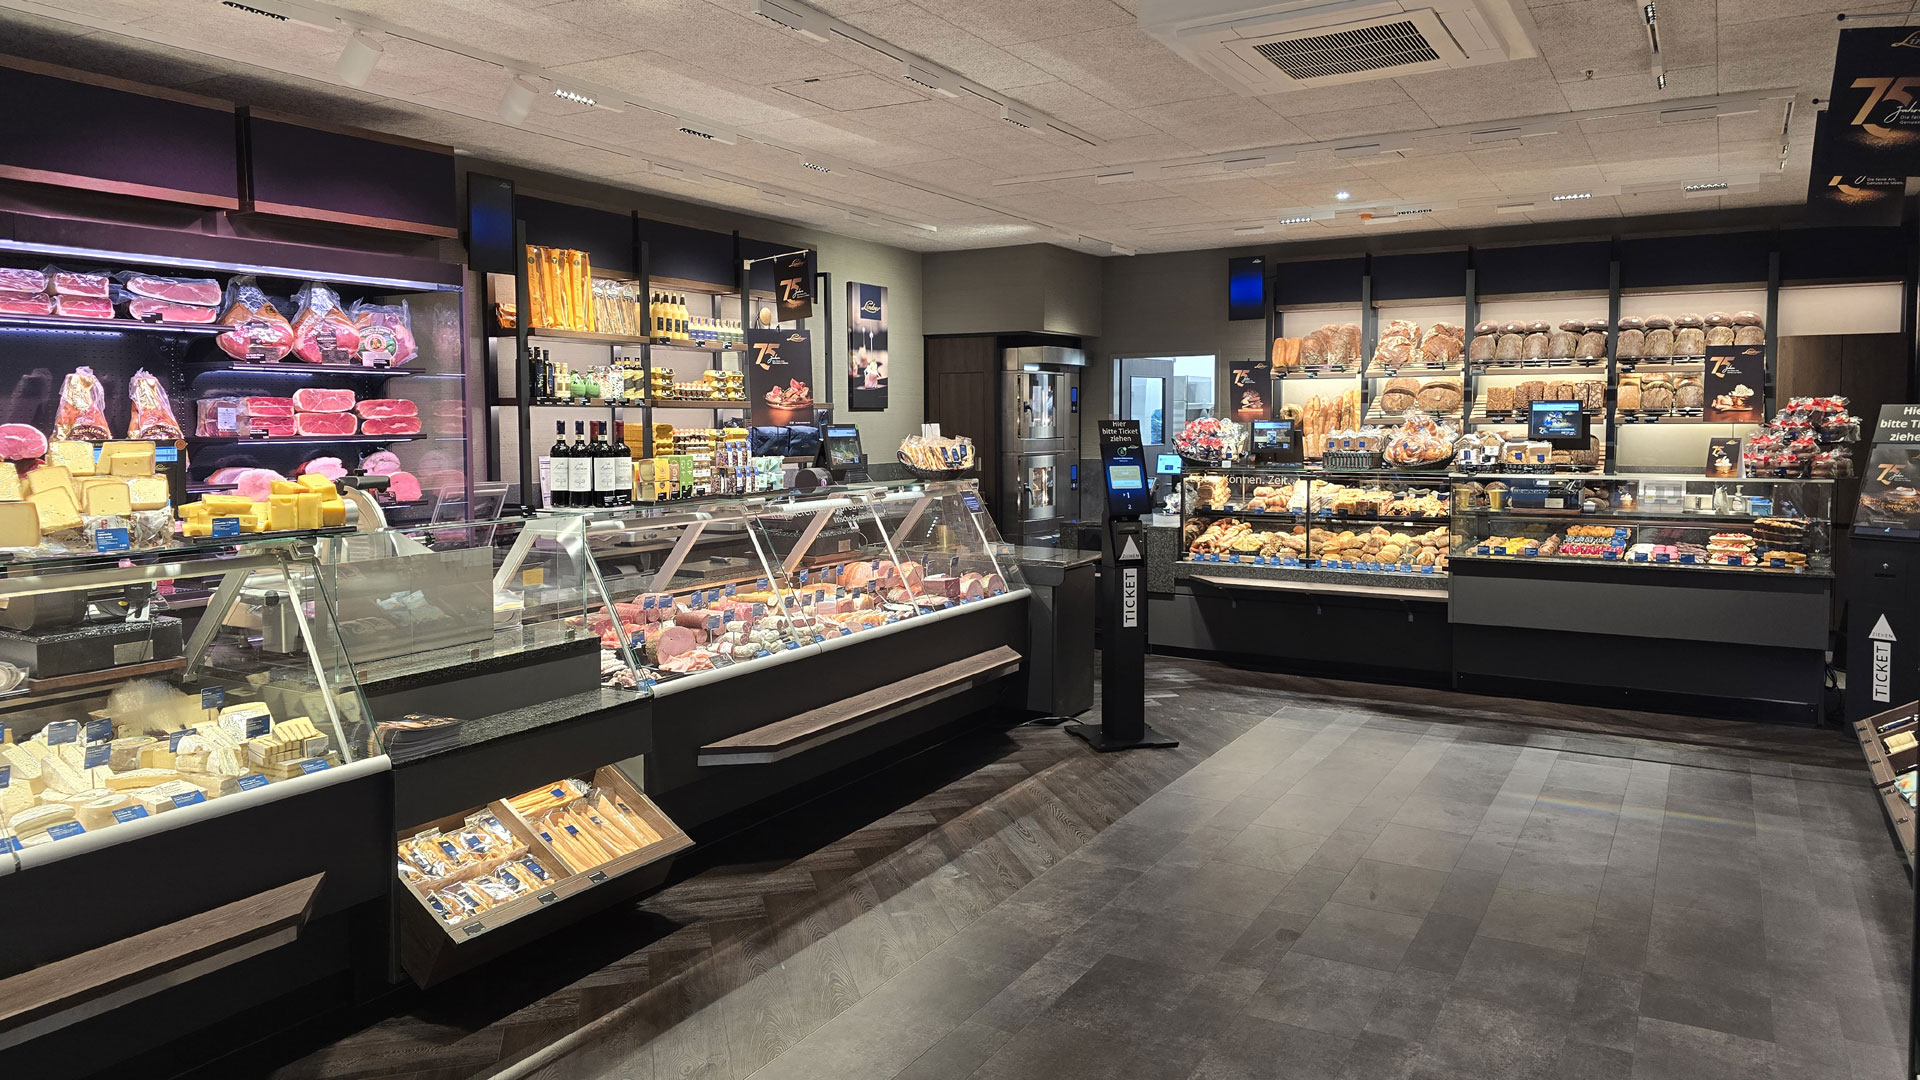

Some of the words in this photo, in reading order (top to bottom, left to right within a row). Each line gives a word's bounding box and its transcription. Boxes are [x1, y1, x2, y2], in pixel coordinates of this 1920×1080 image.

[1850, 77, 1920, 138] 75
[780, 278, 802, 305] 75
[753, 343, 780, 371] 75
[1710, 356, 1735, 378] 75
[1880, 419, 1908, 428] bitte
[1877, 464, 1906, 485] 75
[1125, 572, 1135, 623] TICKET
[1875, 645, 1889, 697] TICKET
